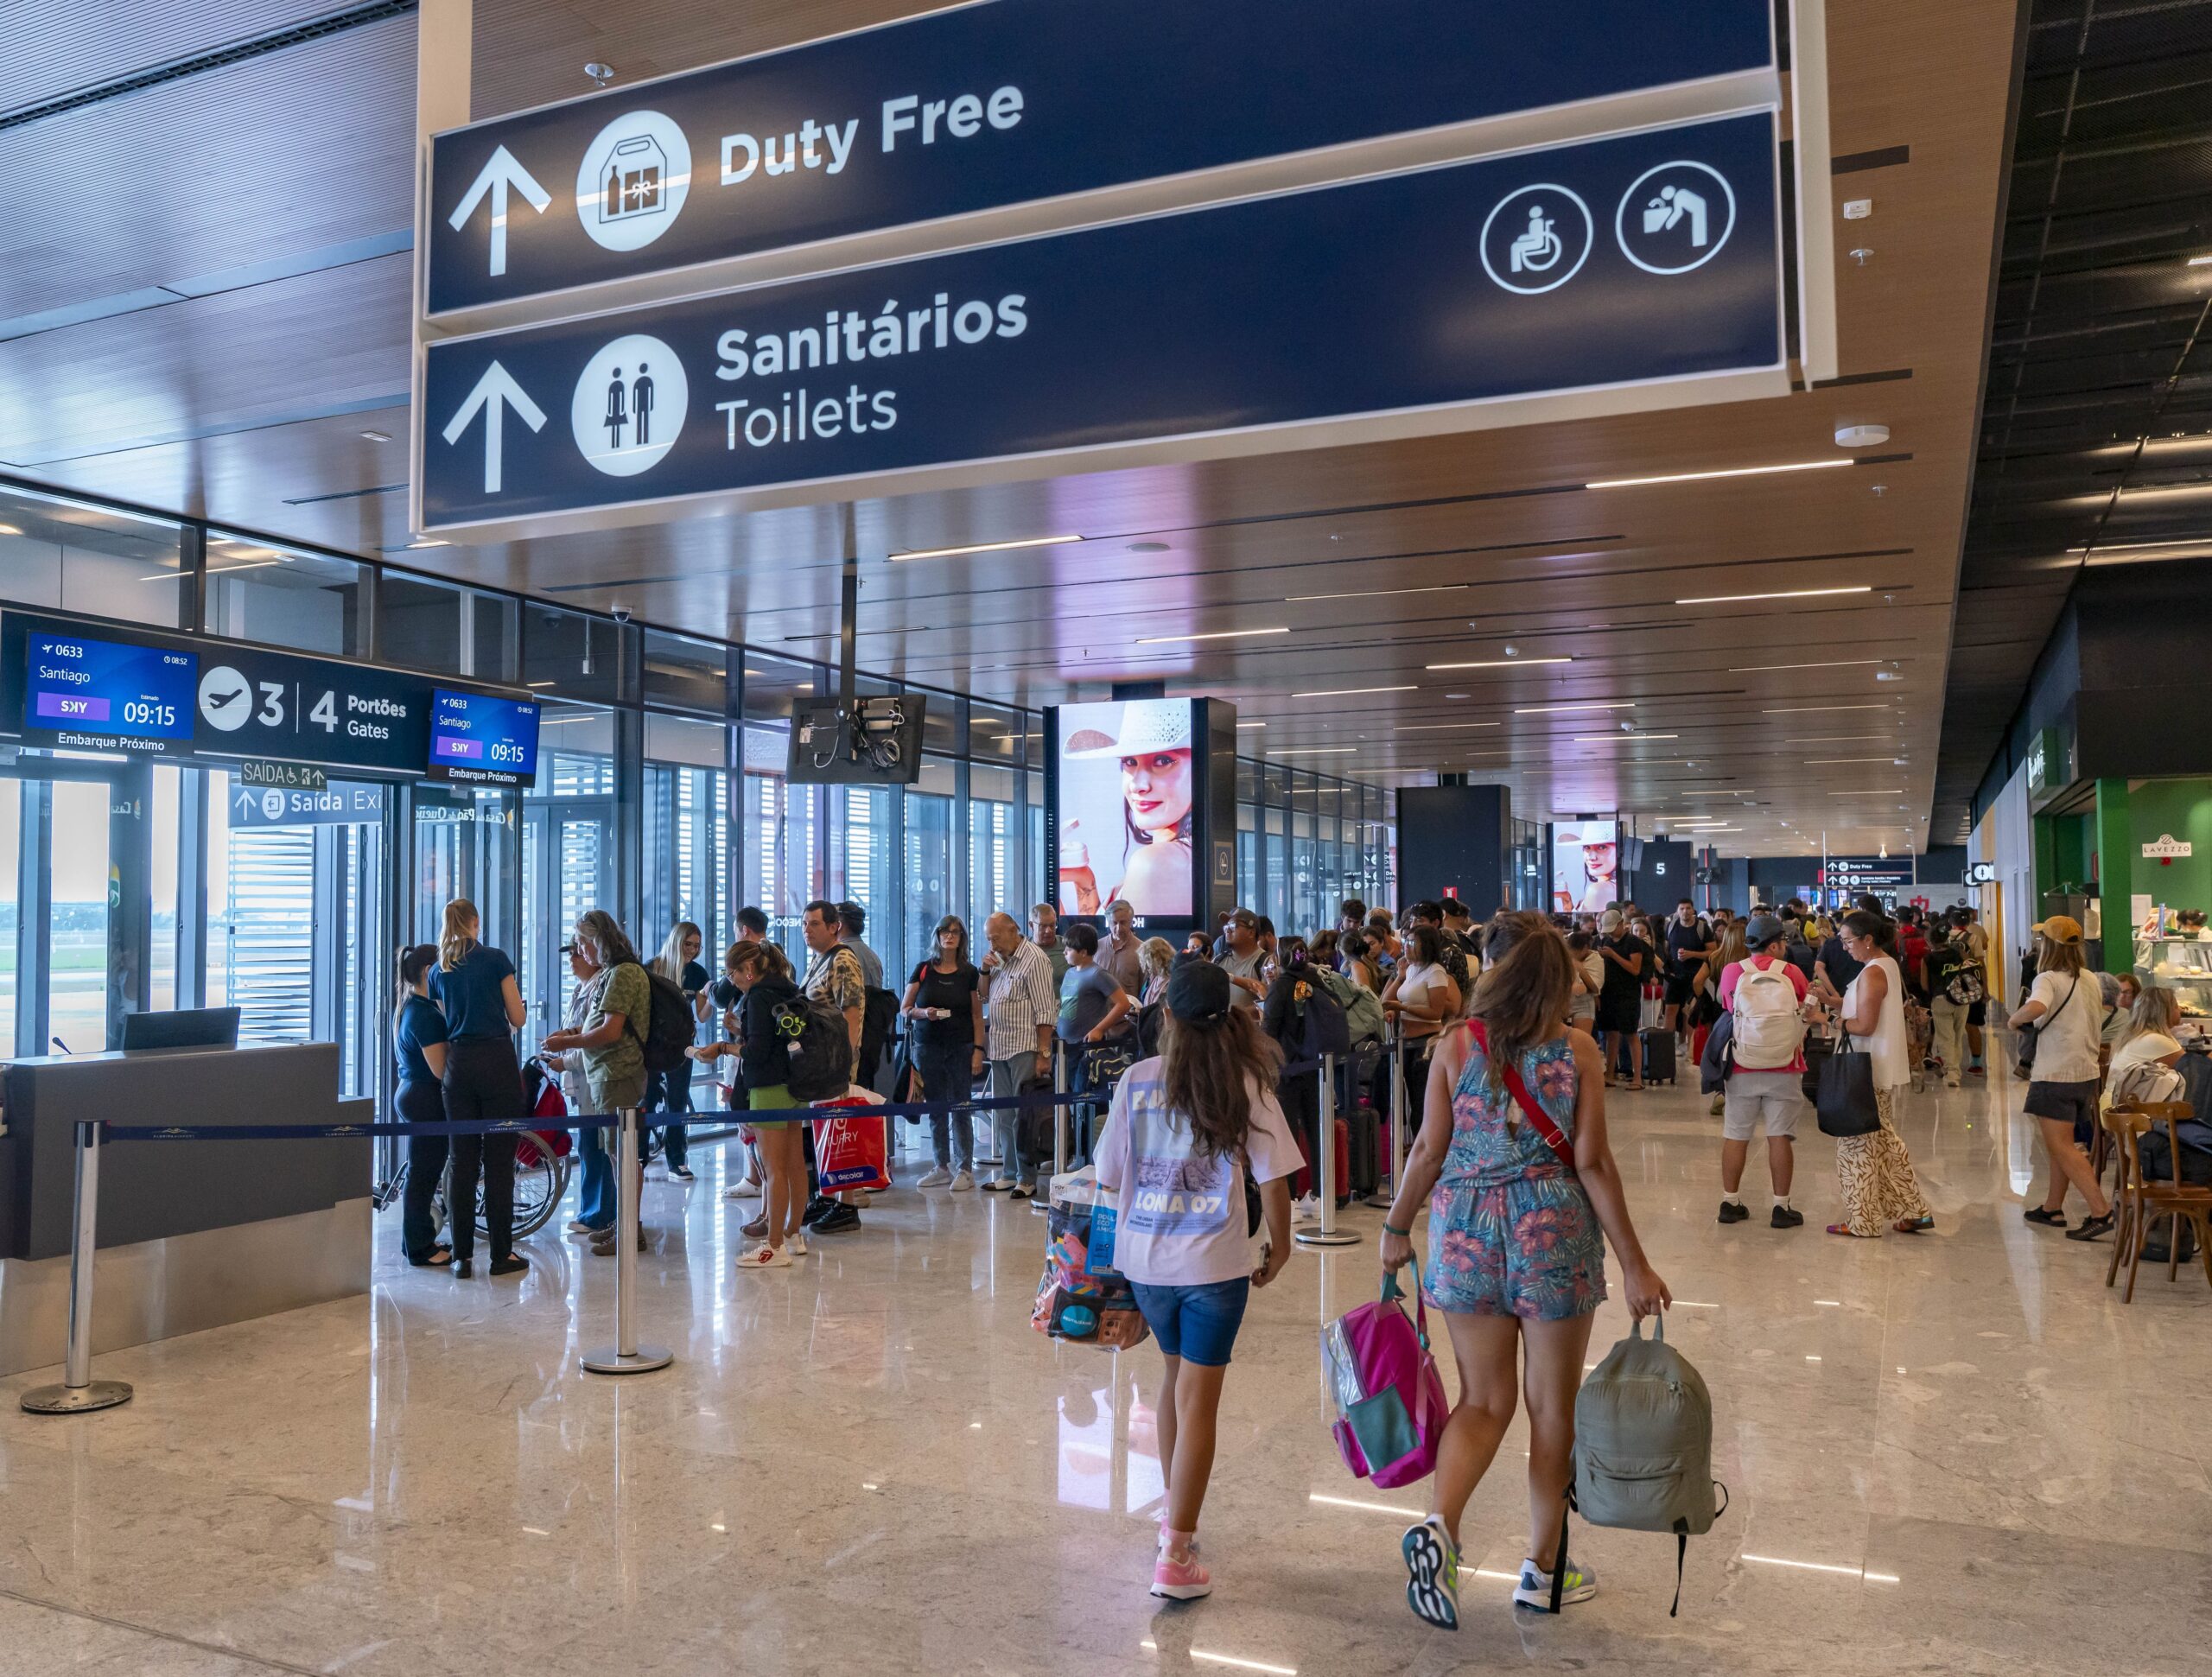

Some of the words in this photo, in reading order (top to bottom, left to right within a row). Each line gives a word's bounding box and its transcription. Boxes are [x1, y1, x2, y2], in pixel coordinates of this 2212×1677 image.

[720, 118, 860, 187] Duty
[881, 85, 1025, 153] Free
[714, 291, 1029, 383] Sanitários
[715, 385, 898, 451] Toilets
[55, 645, 83, 658] 0633
[171, 657, 188, 665] 08:52
[39, 665, 91, 685] Santiago
[60, 700, 87, 714] SKY
[257, 683, 284, 727] 3
[309, 689, 340, 734] 4
[347, 694, 407, 719] Portões
[449, 698, 467, 709] 0633
[124, 702, 175, 726] 09:15
[439, 715, 472, 730] Santiago
[346, 720, 390, 741] Gates
[58, 732, 117, 749] Embarque
[119, 736, 165, 752] Próximo
[451, 742, 468, 753] SKY
[491, 743, 524, 763] 09:15
[244, 760, 285, 784] SAÍDA
[449, 767, 486, 781] Embarque
[487, 771, 517, 783] Próximo
[290, 791, 342, 812] Saída
[354, 790, 381, 810] Exi
[1656, 862, 1665, 875] 5
[837, 1171, 864, 1181] decolar
[1135, 1191, 1186, 1214] LONA
